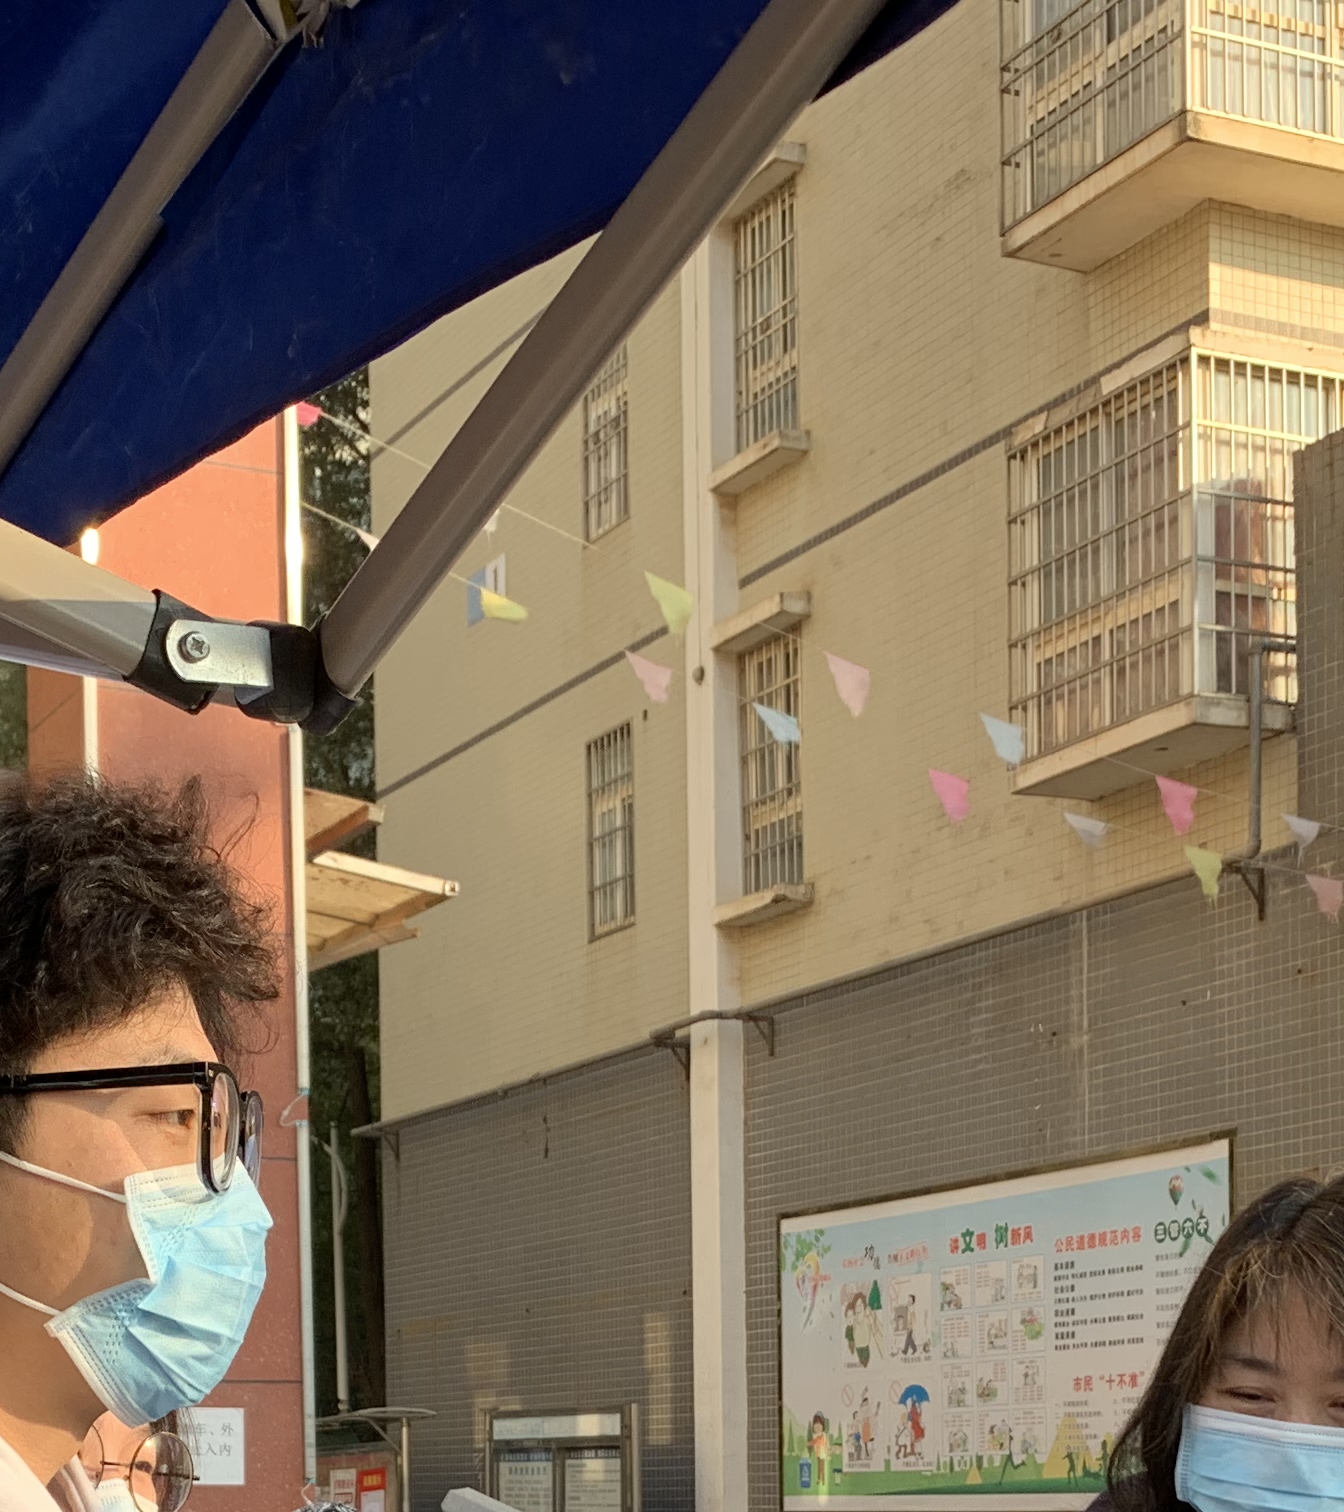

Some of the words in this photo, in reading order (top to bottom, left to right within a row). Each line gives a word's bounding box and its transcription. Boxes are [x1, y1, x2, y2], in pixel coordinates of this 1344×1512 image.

[1054, 1226, 1143, 1253] 公民道德规范内容
